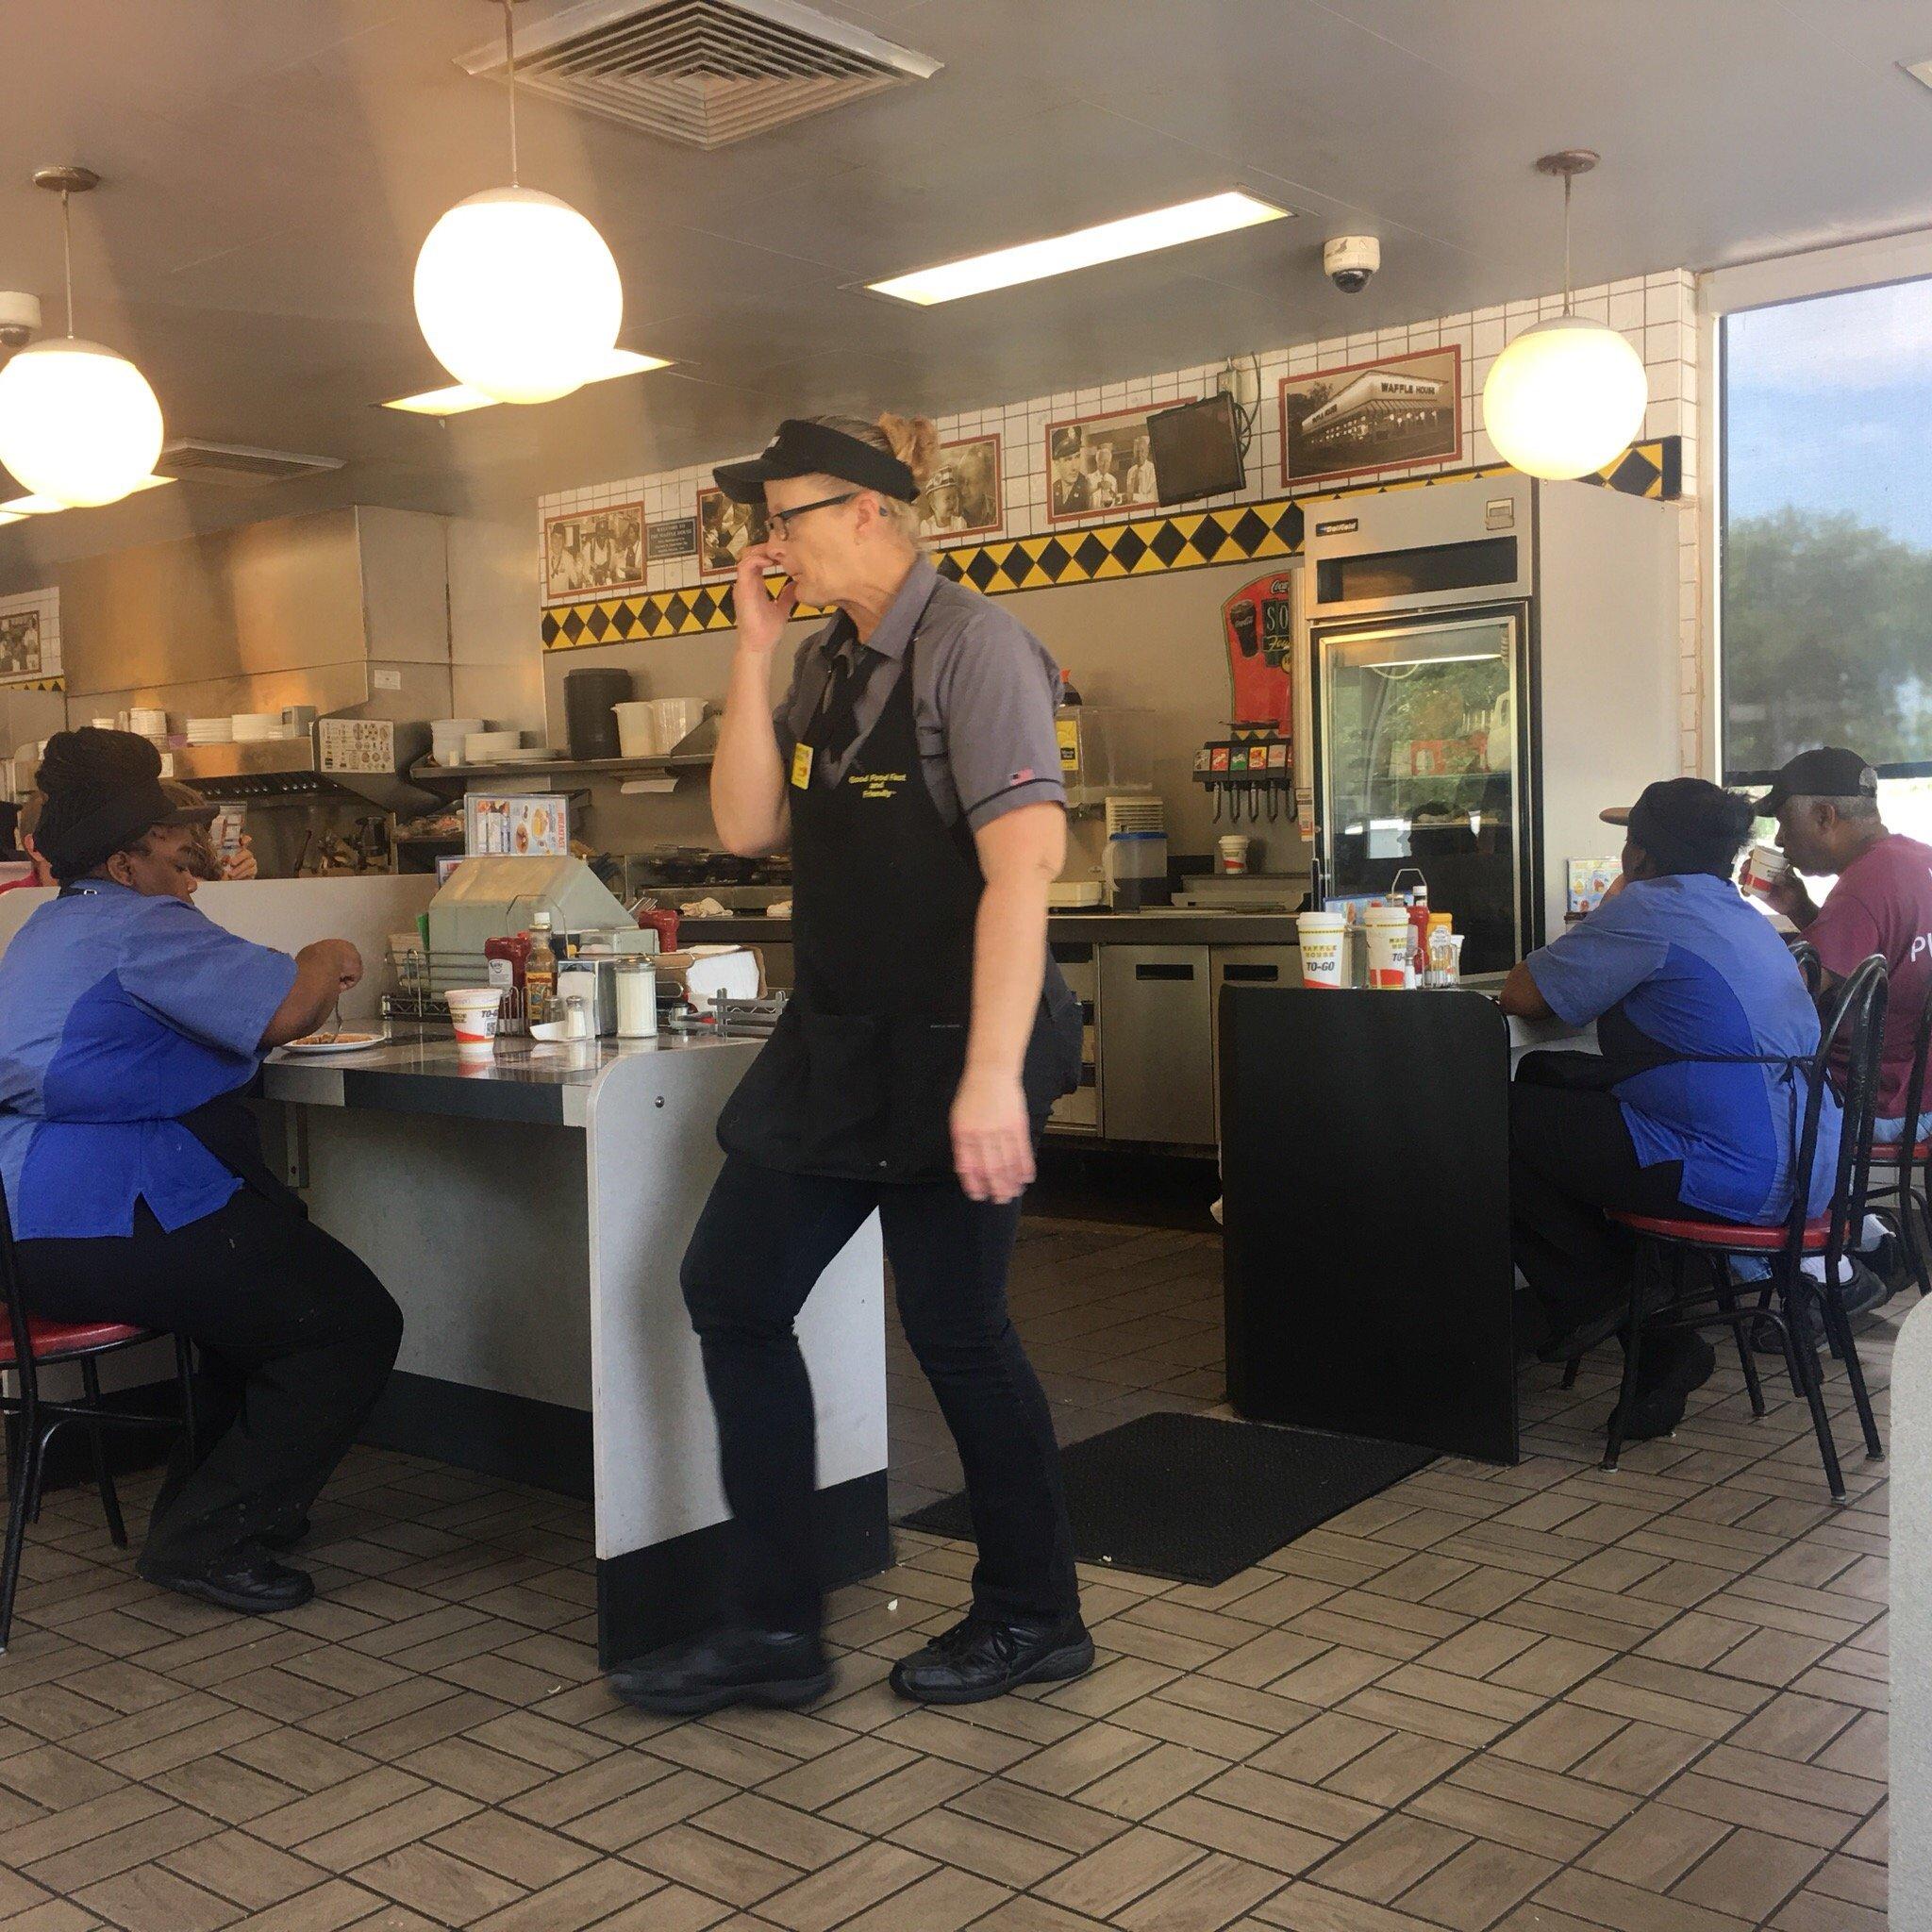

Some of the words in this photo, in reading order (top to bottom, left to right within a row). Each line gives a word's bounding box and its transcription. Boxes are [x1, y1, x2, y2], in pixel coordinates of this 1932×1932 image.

[1381, 382, 1413, 393] WAFFLE
[1415, 385, 1436, 394] HOUSE
[1306, 961, 1335, 972] TO-GO
